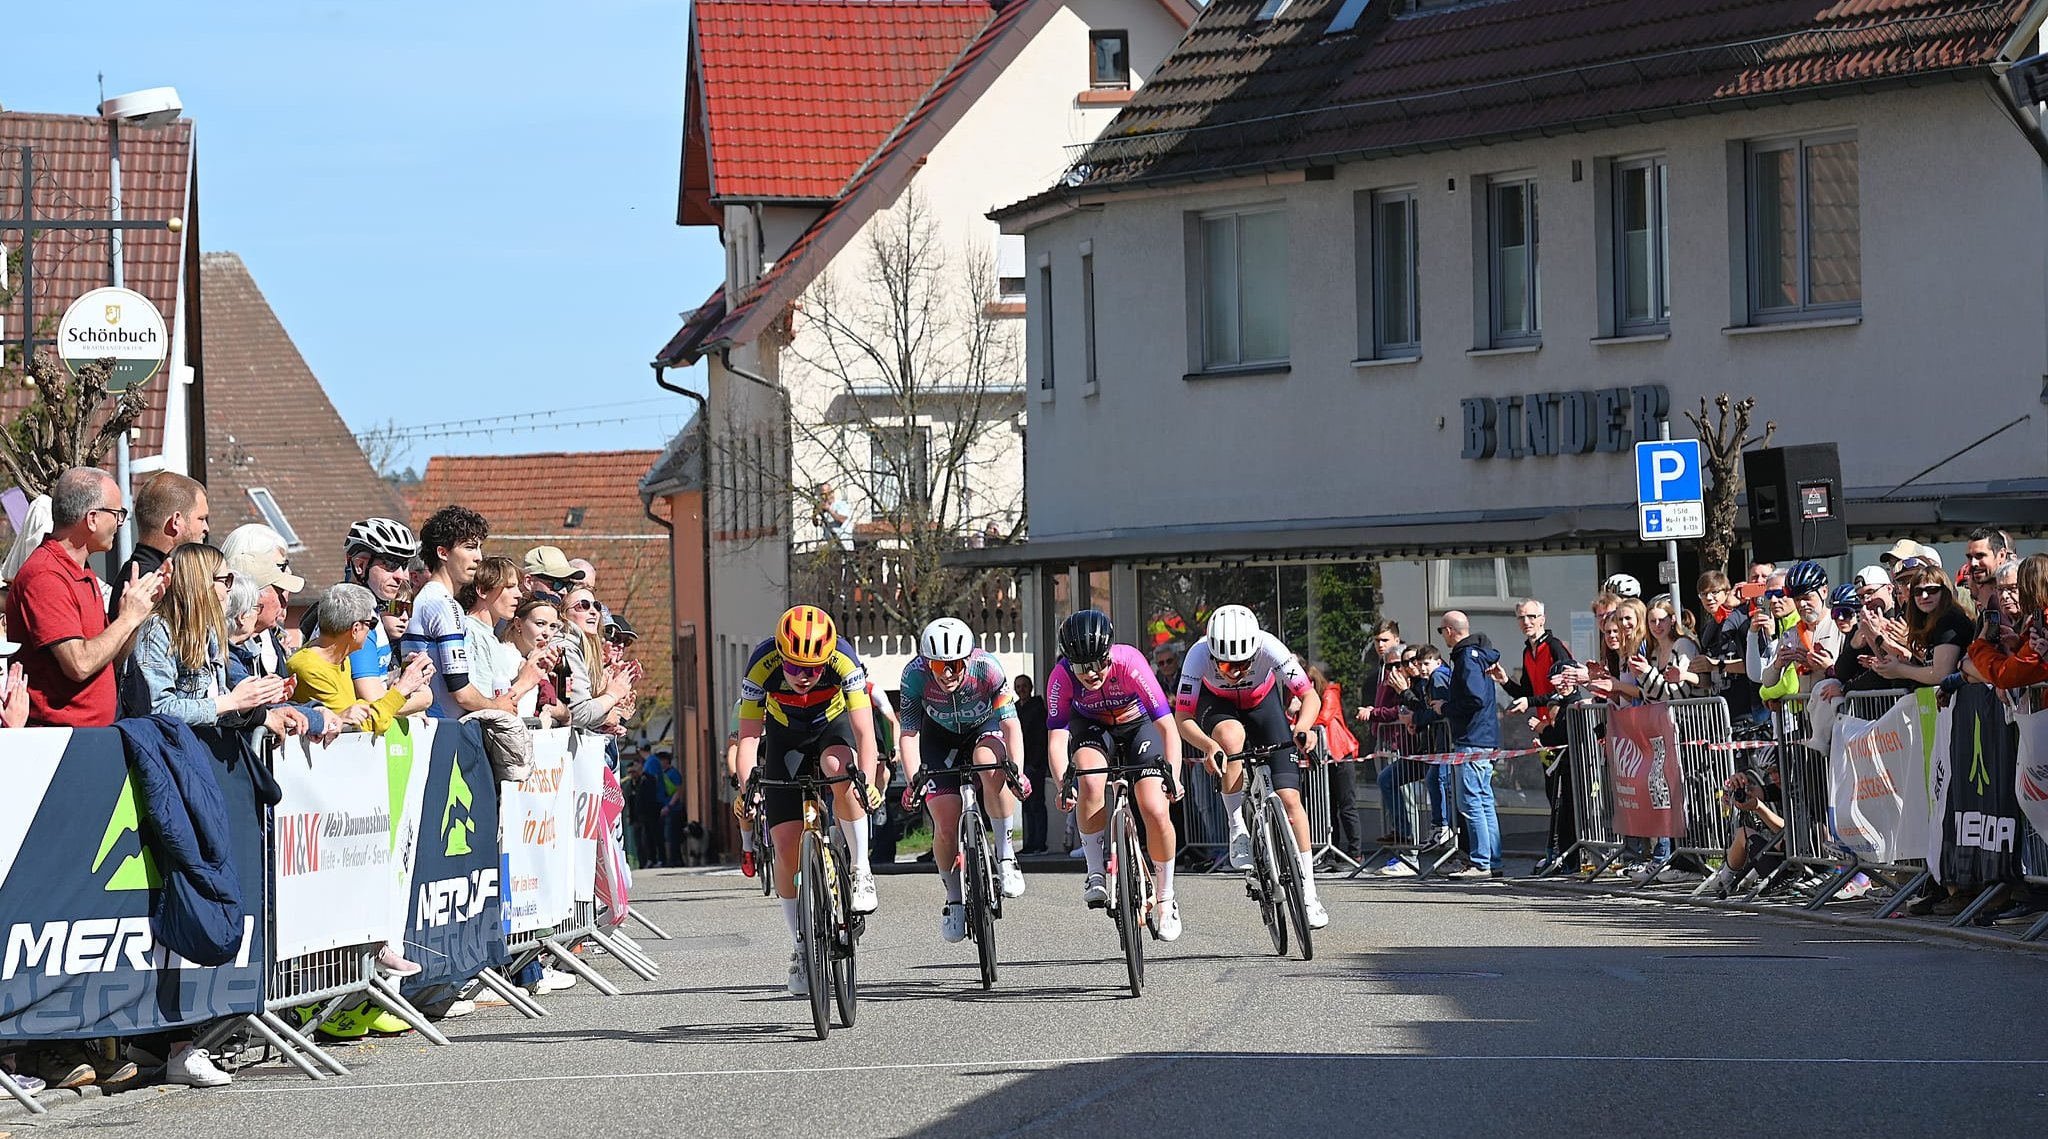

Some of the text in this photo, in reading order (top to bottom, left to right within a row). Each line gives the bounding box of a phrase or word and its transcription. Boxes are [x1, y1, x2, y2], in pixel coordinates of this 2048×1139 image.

[68, 326, 156, 343] Schönbuch
[1461, 385, 1670, 459] BINDER
[1653, 450, 1686, 500] P
[323, 811, 344, 838] Veit
[2, 915, 254, 981] MER
